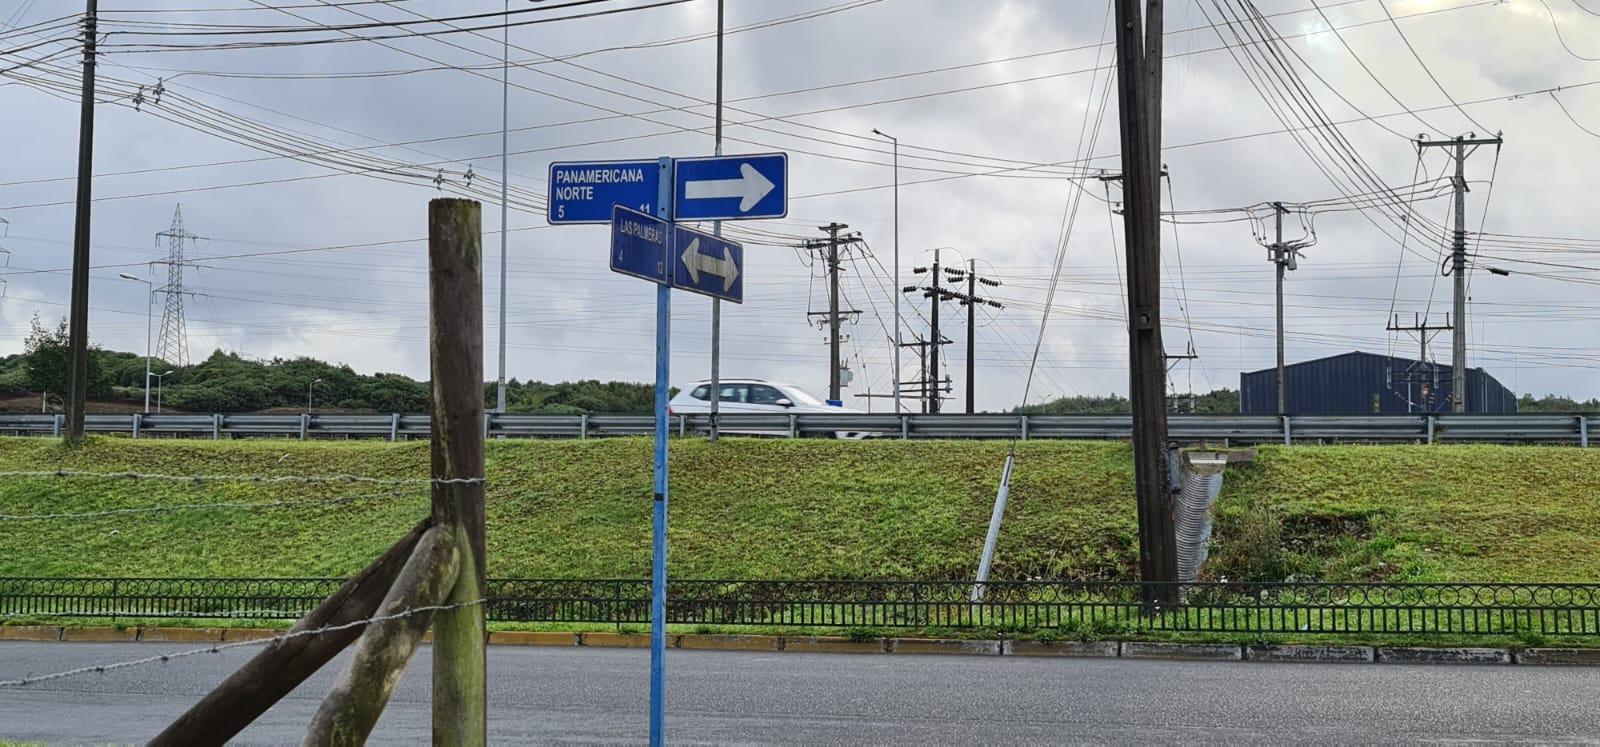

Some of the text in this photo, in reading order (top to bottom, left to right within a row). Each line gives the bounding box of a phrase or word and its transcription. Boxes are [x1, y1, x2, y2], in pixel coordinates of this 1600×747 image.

[556, 168, 644, 184] PANAMERICANA
[556, 186, 594, 201] NORTE
[558, 204, 565, 219] 5
[620, 217, 664, 245] LAS PALMERAS
[618, 248, 664, 275] 4 12
